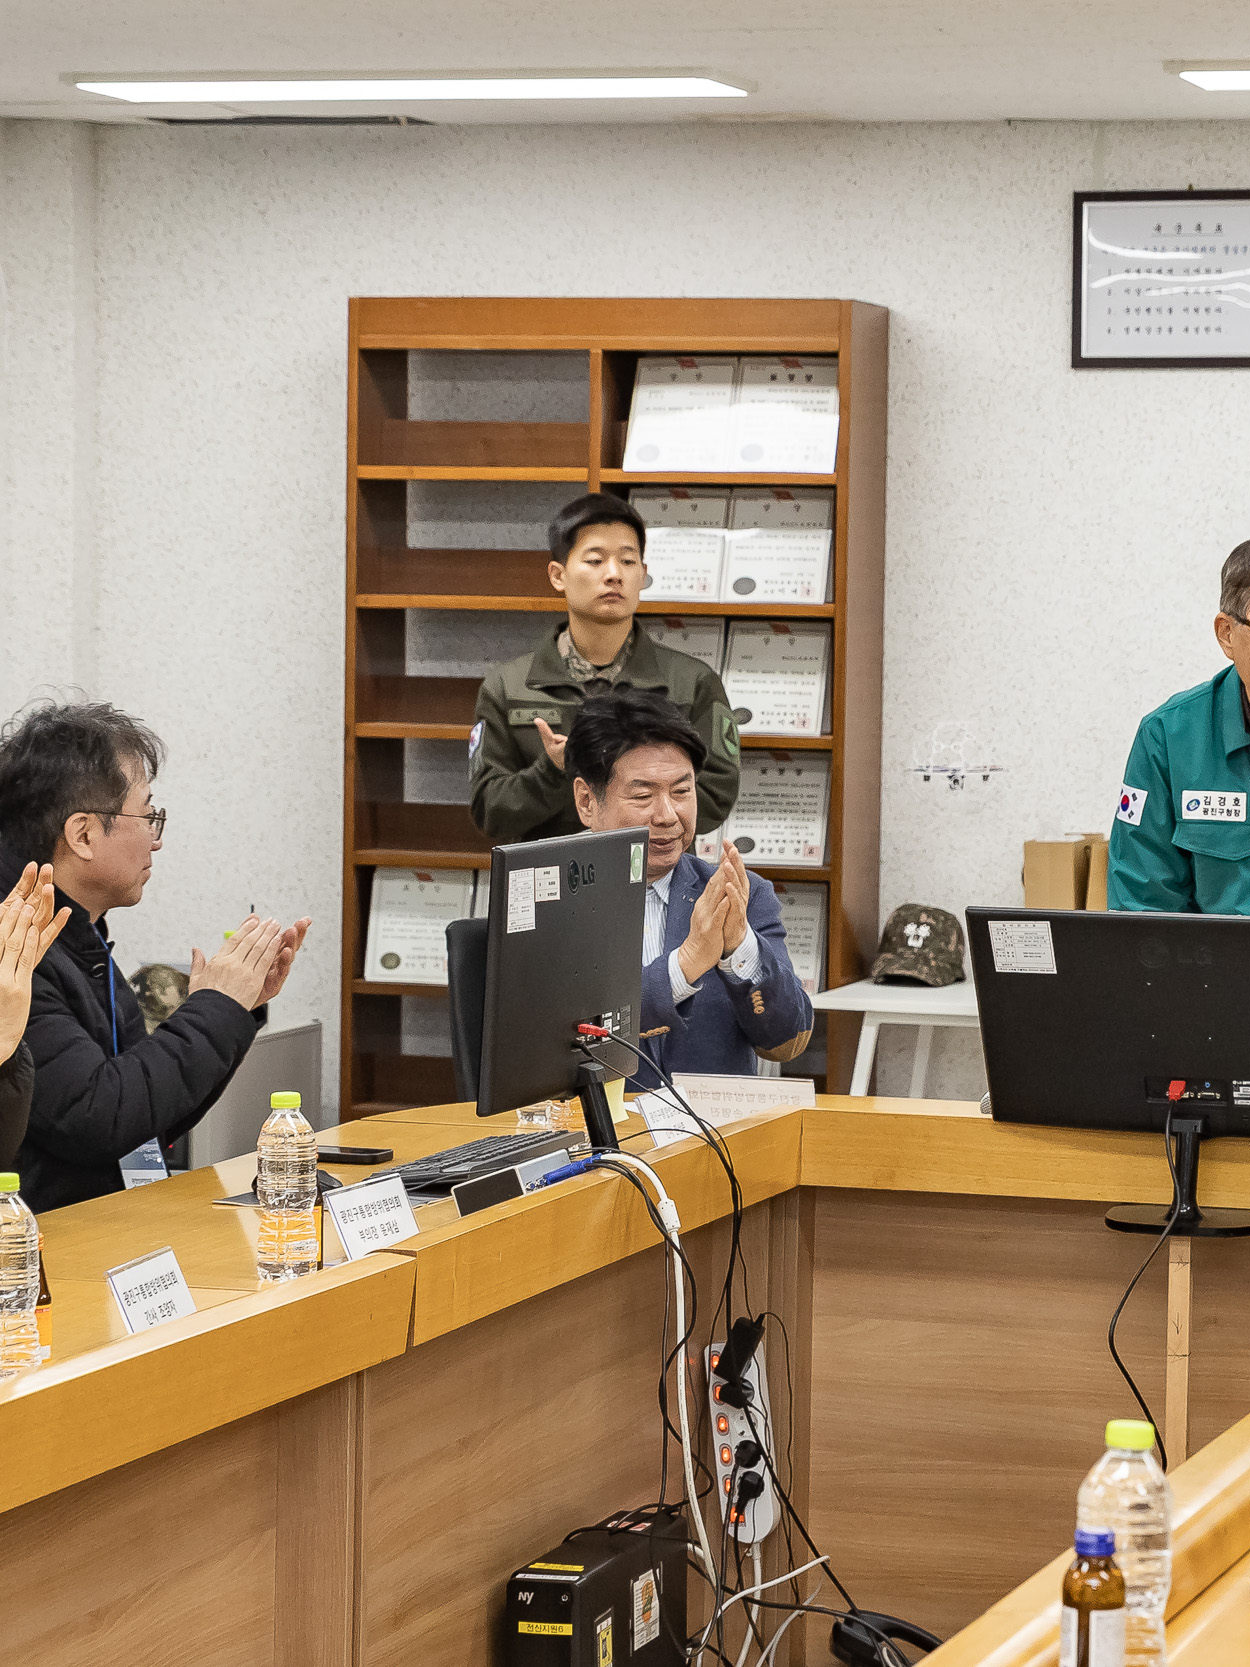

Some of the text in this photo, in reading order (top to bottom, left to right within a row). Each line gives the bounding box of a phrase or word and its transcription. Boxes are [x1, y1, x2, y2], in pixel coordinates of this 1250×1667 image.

[1202, 808, 1241, 817] 광진구청장
[582, 863, 596, 885] LG
[339, 1195, 403, 1224] 광진구통합방위협의회
[359, 1225, 380, 1243] 부의장
[123, 1270, 180, 1307] 광진구통합방위협의회
[144, 1307, 160, 1326] 간사
